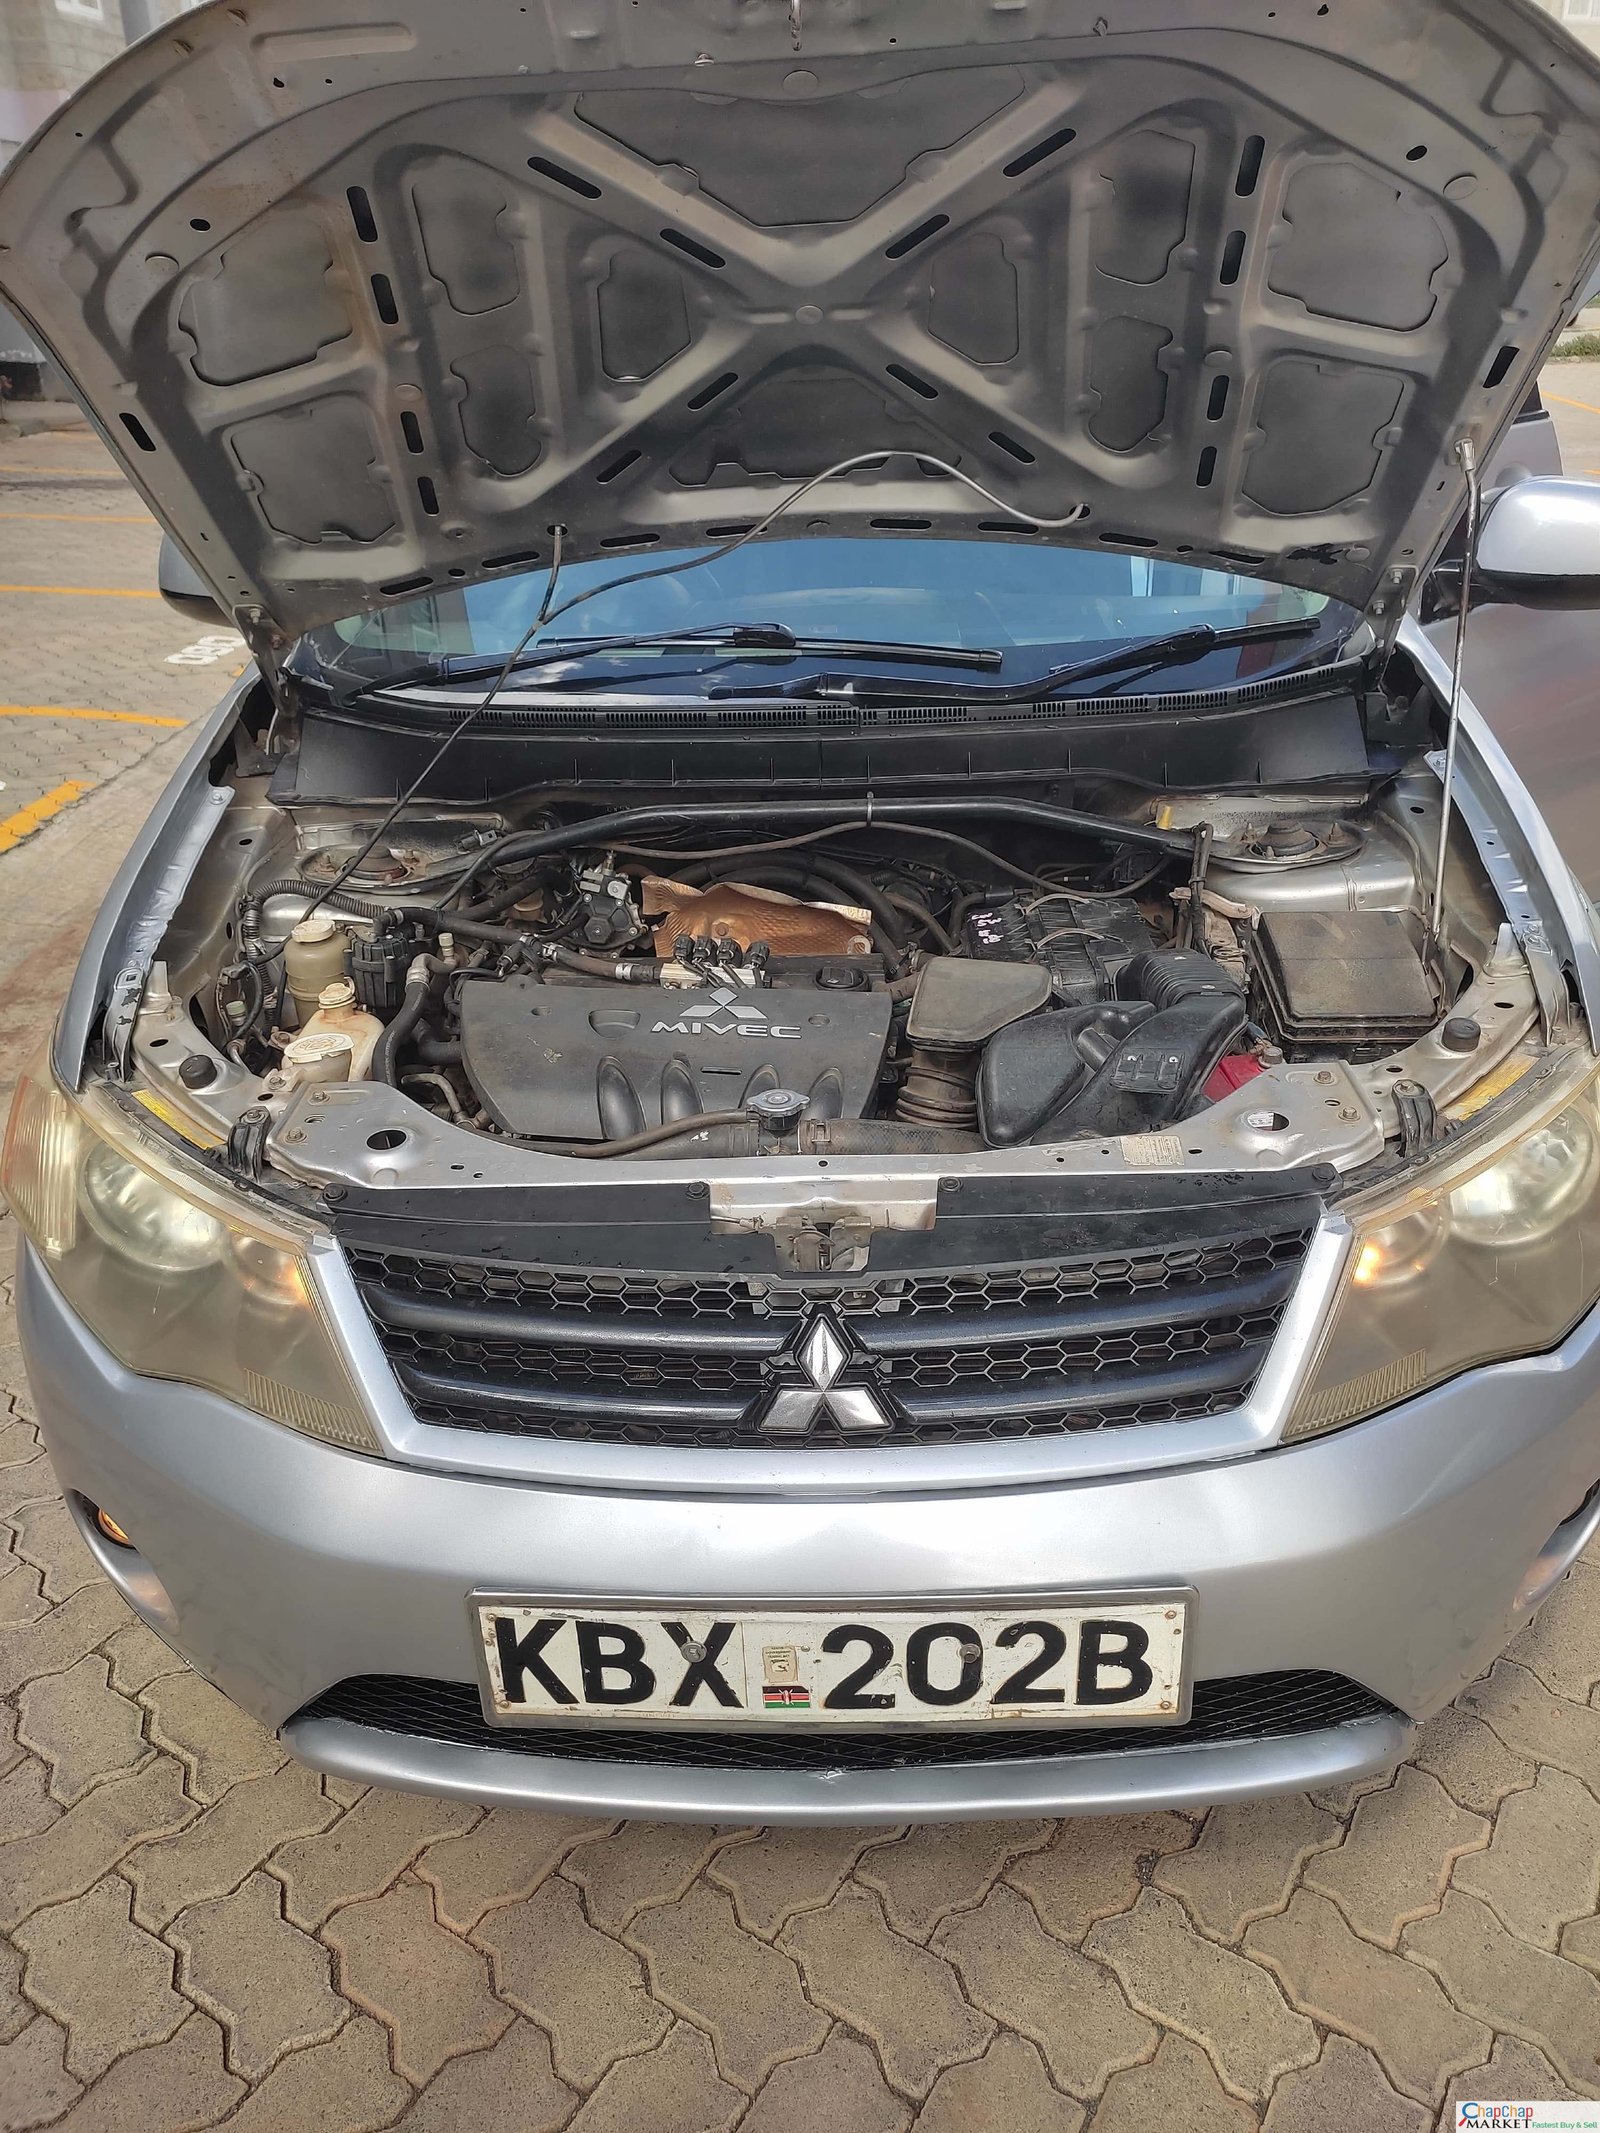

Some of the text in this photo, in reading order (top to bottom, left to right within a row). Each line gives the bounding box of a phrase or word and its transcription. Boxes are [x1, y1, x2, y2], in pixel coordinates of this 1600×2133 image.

[651, 1021, 801, 1039] MIVEC
[495, 1616, 1153, 1709] KBX 202B
